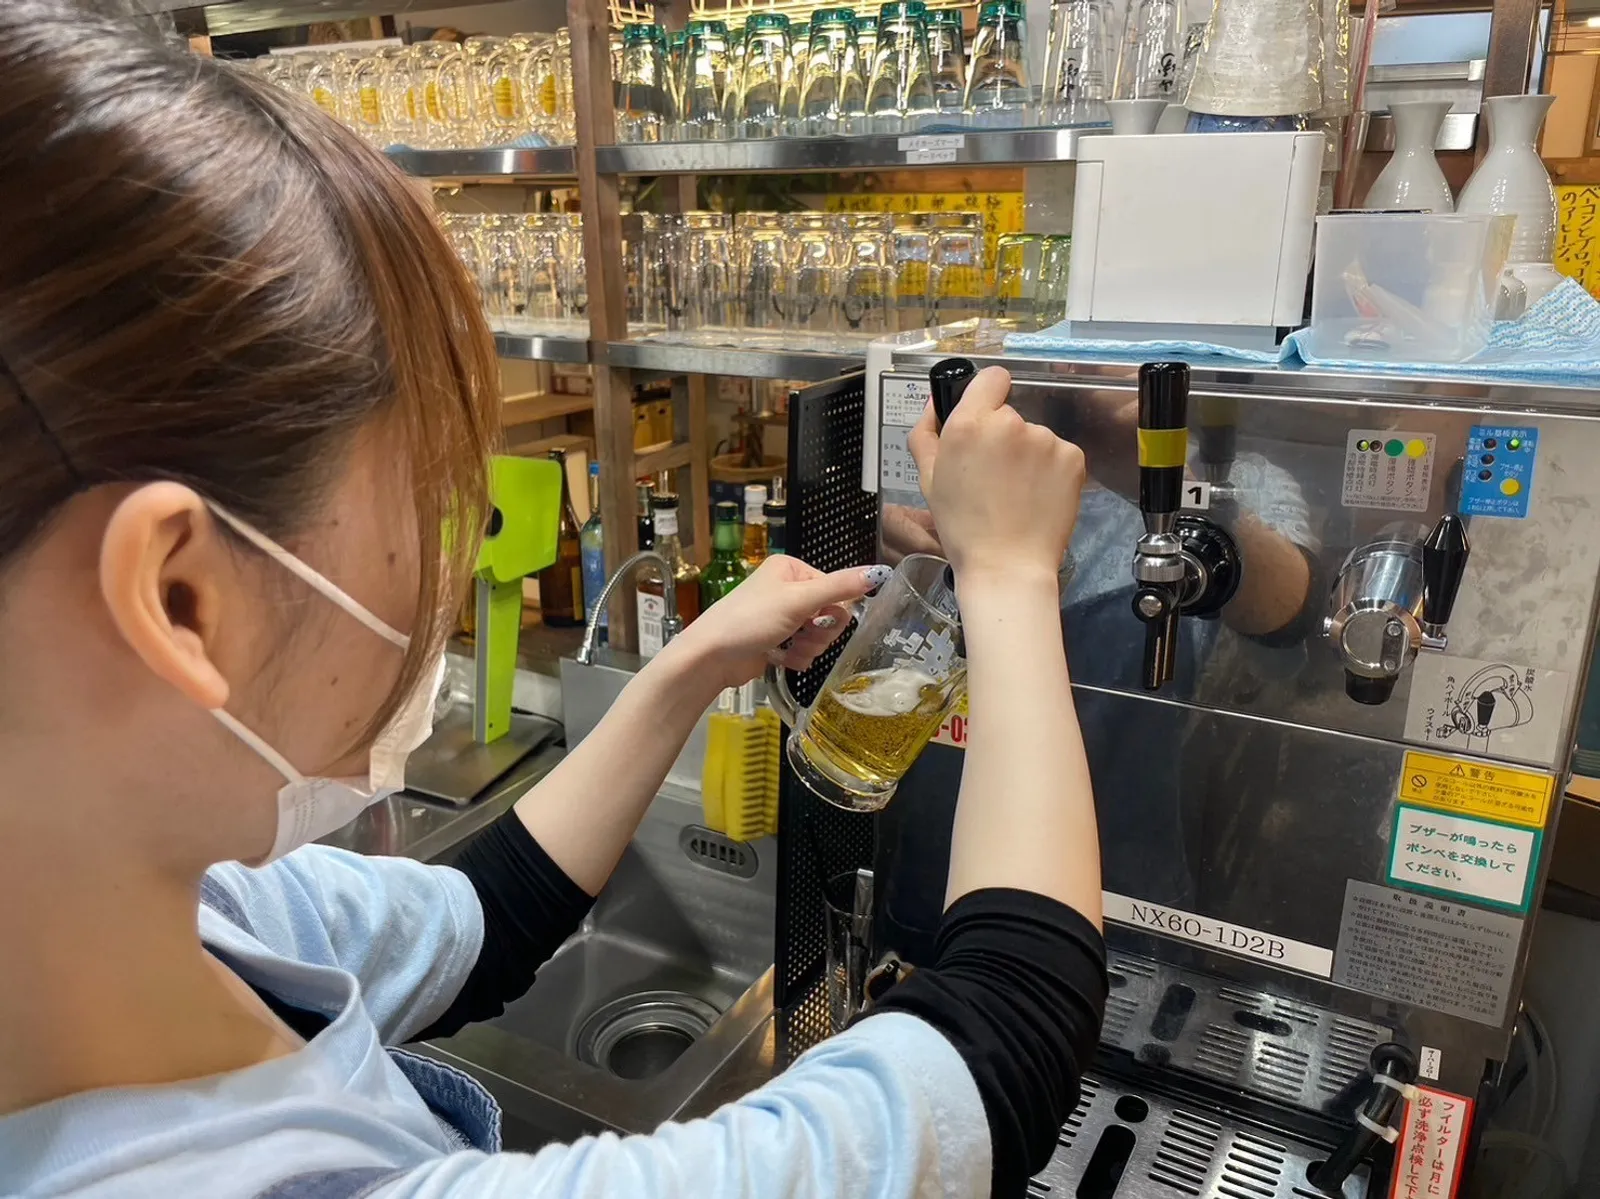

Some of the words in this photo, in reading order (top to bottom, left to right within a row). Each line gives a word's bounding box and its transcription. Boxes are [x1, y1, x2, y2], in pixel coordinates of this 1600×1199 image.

[1187, 487, 1202, 505] 1
[1409, 824, 1517, 854] ブザーが鳴ったら
[1405, 861, 1462, 881] ください。
[1406, 842, 1516, 873] ボンベを交換して
[1404, 1096, 1433, 1199] 必ず洗浄点検して下
